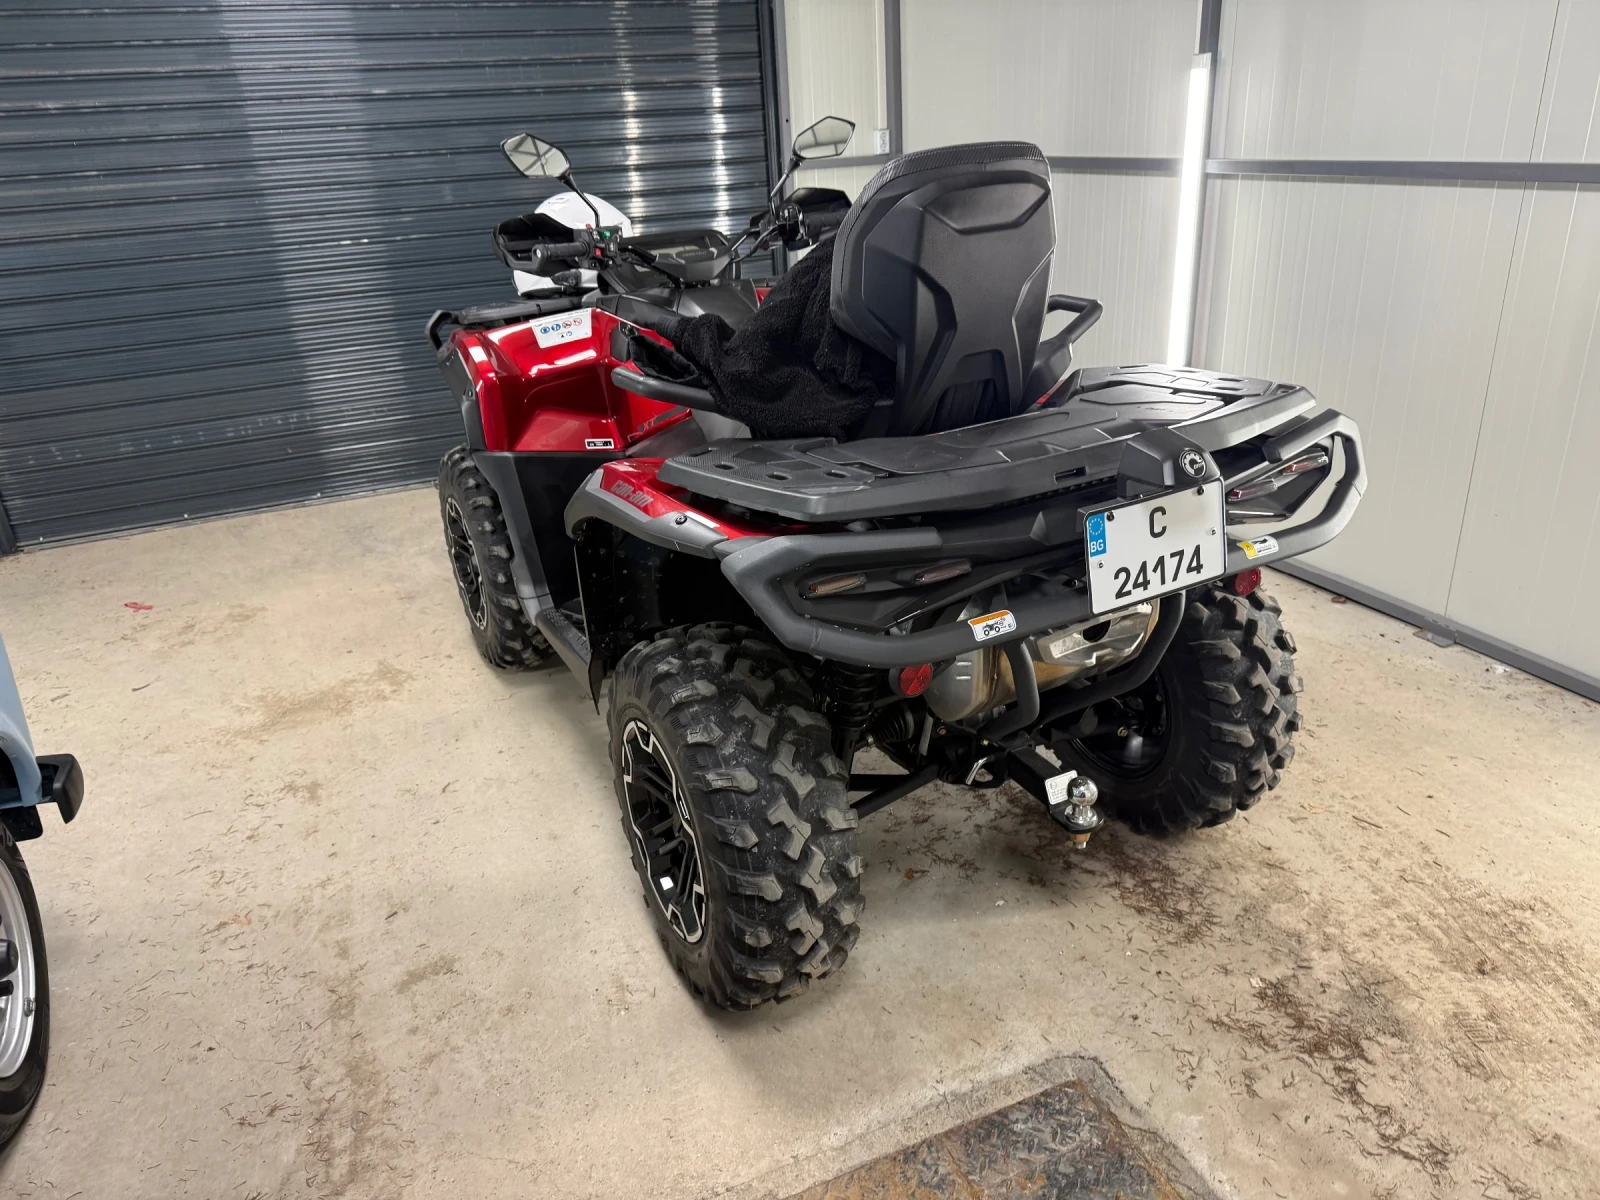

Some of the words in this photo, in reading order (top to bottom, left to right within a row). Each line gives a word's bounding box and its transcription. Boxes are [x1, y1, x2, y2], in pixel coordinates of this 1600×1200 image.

[1149, 506, 1167, 538] C
[1090, 540, 1104, 553] BG
[1113, 545, 1203, 600] 24174
